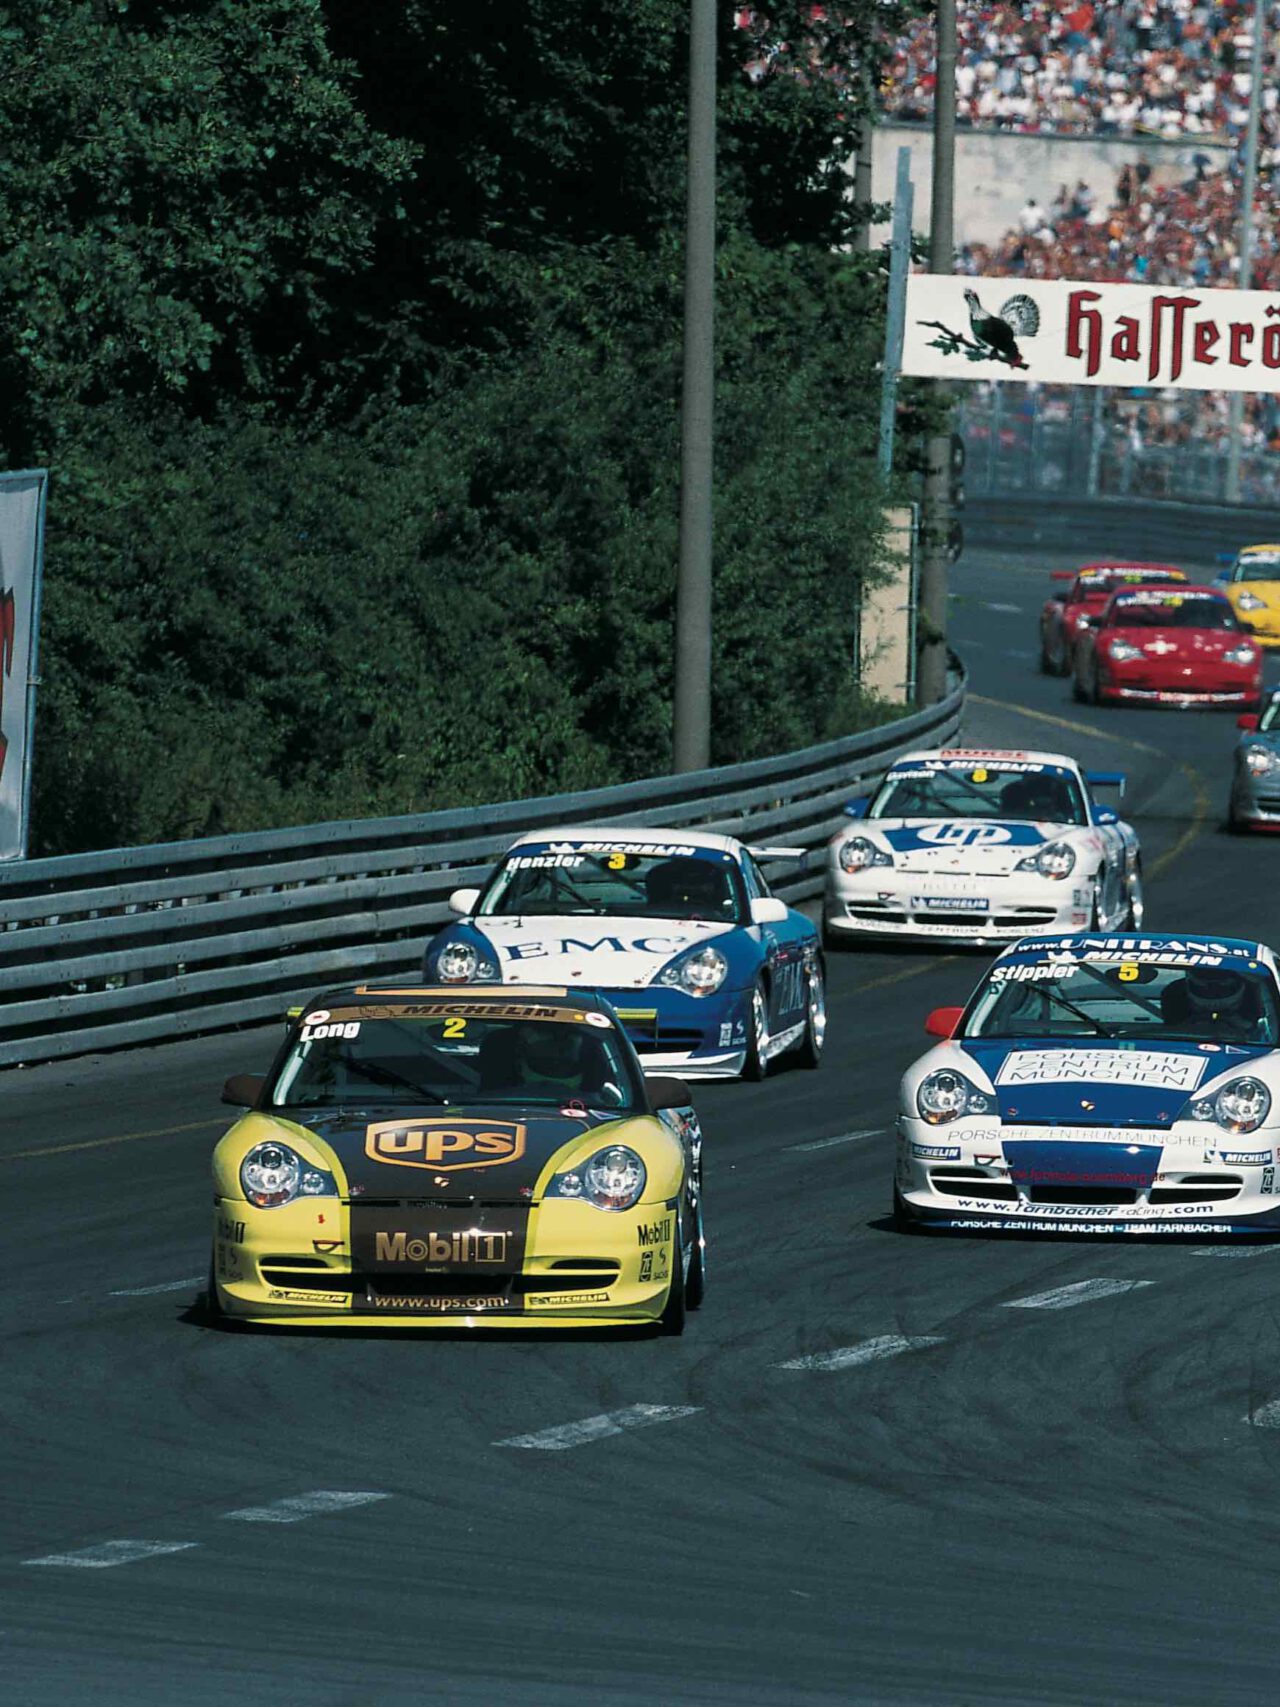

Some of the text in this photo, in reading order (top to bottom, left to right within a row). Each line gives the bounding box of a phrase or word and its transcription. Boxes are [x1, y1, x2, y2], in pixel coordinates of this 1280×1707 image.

[949, 761, 1045, 773] MICHELIN
[933, 823, 997, 846] hp
[578, 842, 697, 857] MICHELIN
[506, 854, 586, 872] Henzler
[608, 852, 627, 870] 3
[928, 898, 988, 910] MICHELIN
[1017, 938, 1250, 958] www.UNITRANS.at
[1083, 950, 1224, 966] MICHELIN
[989, 962, 1080, 983] Stippler
[1118, 962, 1139, 981] 5
[401, 1005, 559, 1018] MICHELIN
[300, 1021, 361, 1042] Long
[442, 1017, 467, 1038] 2
[1018, 1051, 1193, 1065] PORSCHE
[1016, 1060, 1189, 1075] ZENTRUM
[948, 1129, 1030, 1142] PORSCHE
[1037, 1129, 1122, 1142] ZENTRUM
[378, 1130, 515, 1161] ups
[914, 1147, 960, 1158] MICHELIN
[1224, 1151, 1272, 1163] MICHELIN
[637, 1221, 663, 1247] Mobil
[1158, 1223, 1233, 1235] FARNBACHER
[375, 1231, 470, 1262] Mobil
[285, 1291, 347, 1303] MICHELIN
[375, 1295, 506, 1312] www.ups.com
[549, 1293, 608, 1303] MICHELIN
